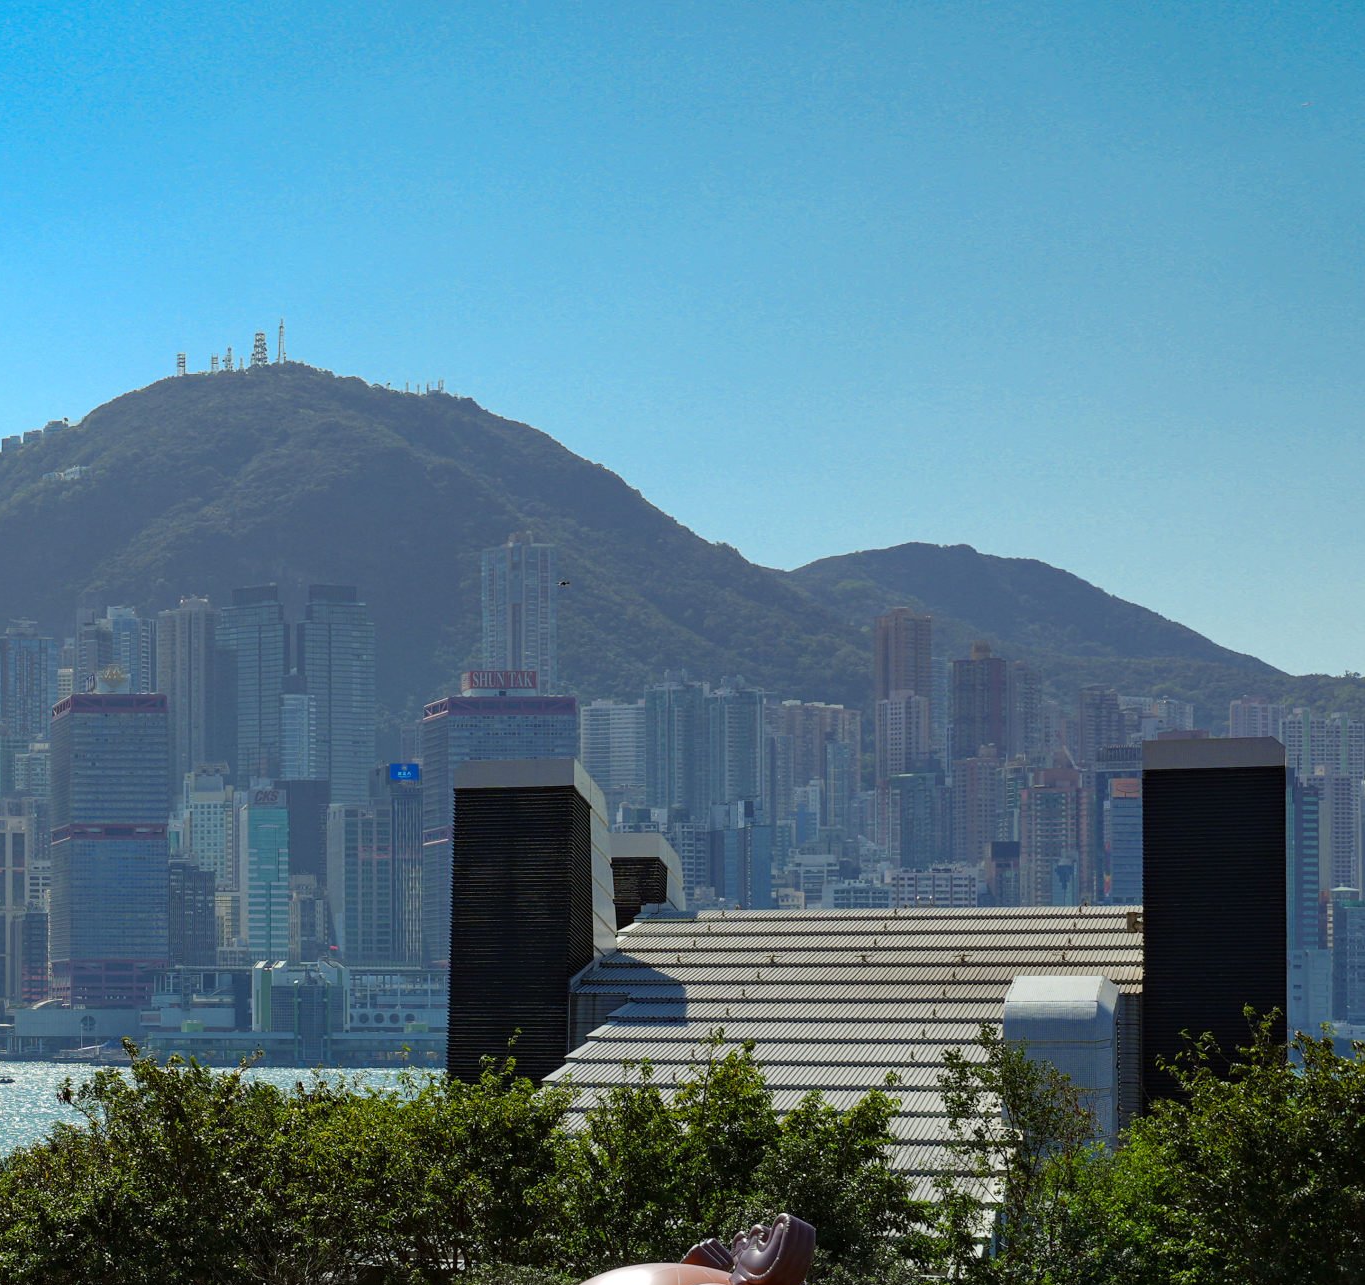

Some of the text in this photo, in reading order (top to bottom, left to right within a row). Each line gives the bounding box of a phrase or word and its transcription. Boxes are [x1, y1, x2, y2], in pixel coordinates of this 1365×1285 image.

[472, 671, 505, 688] SHUN
[508, 671, 533, 688] TAK
[255, 790, 279, 802] CKS
